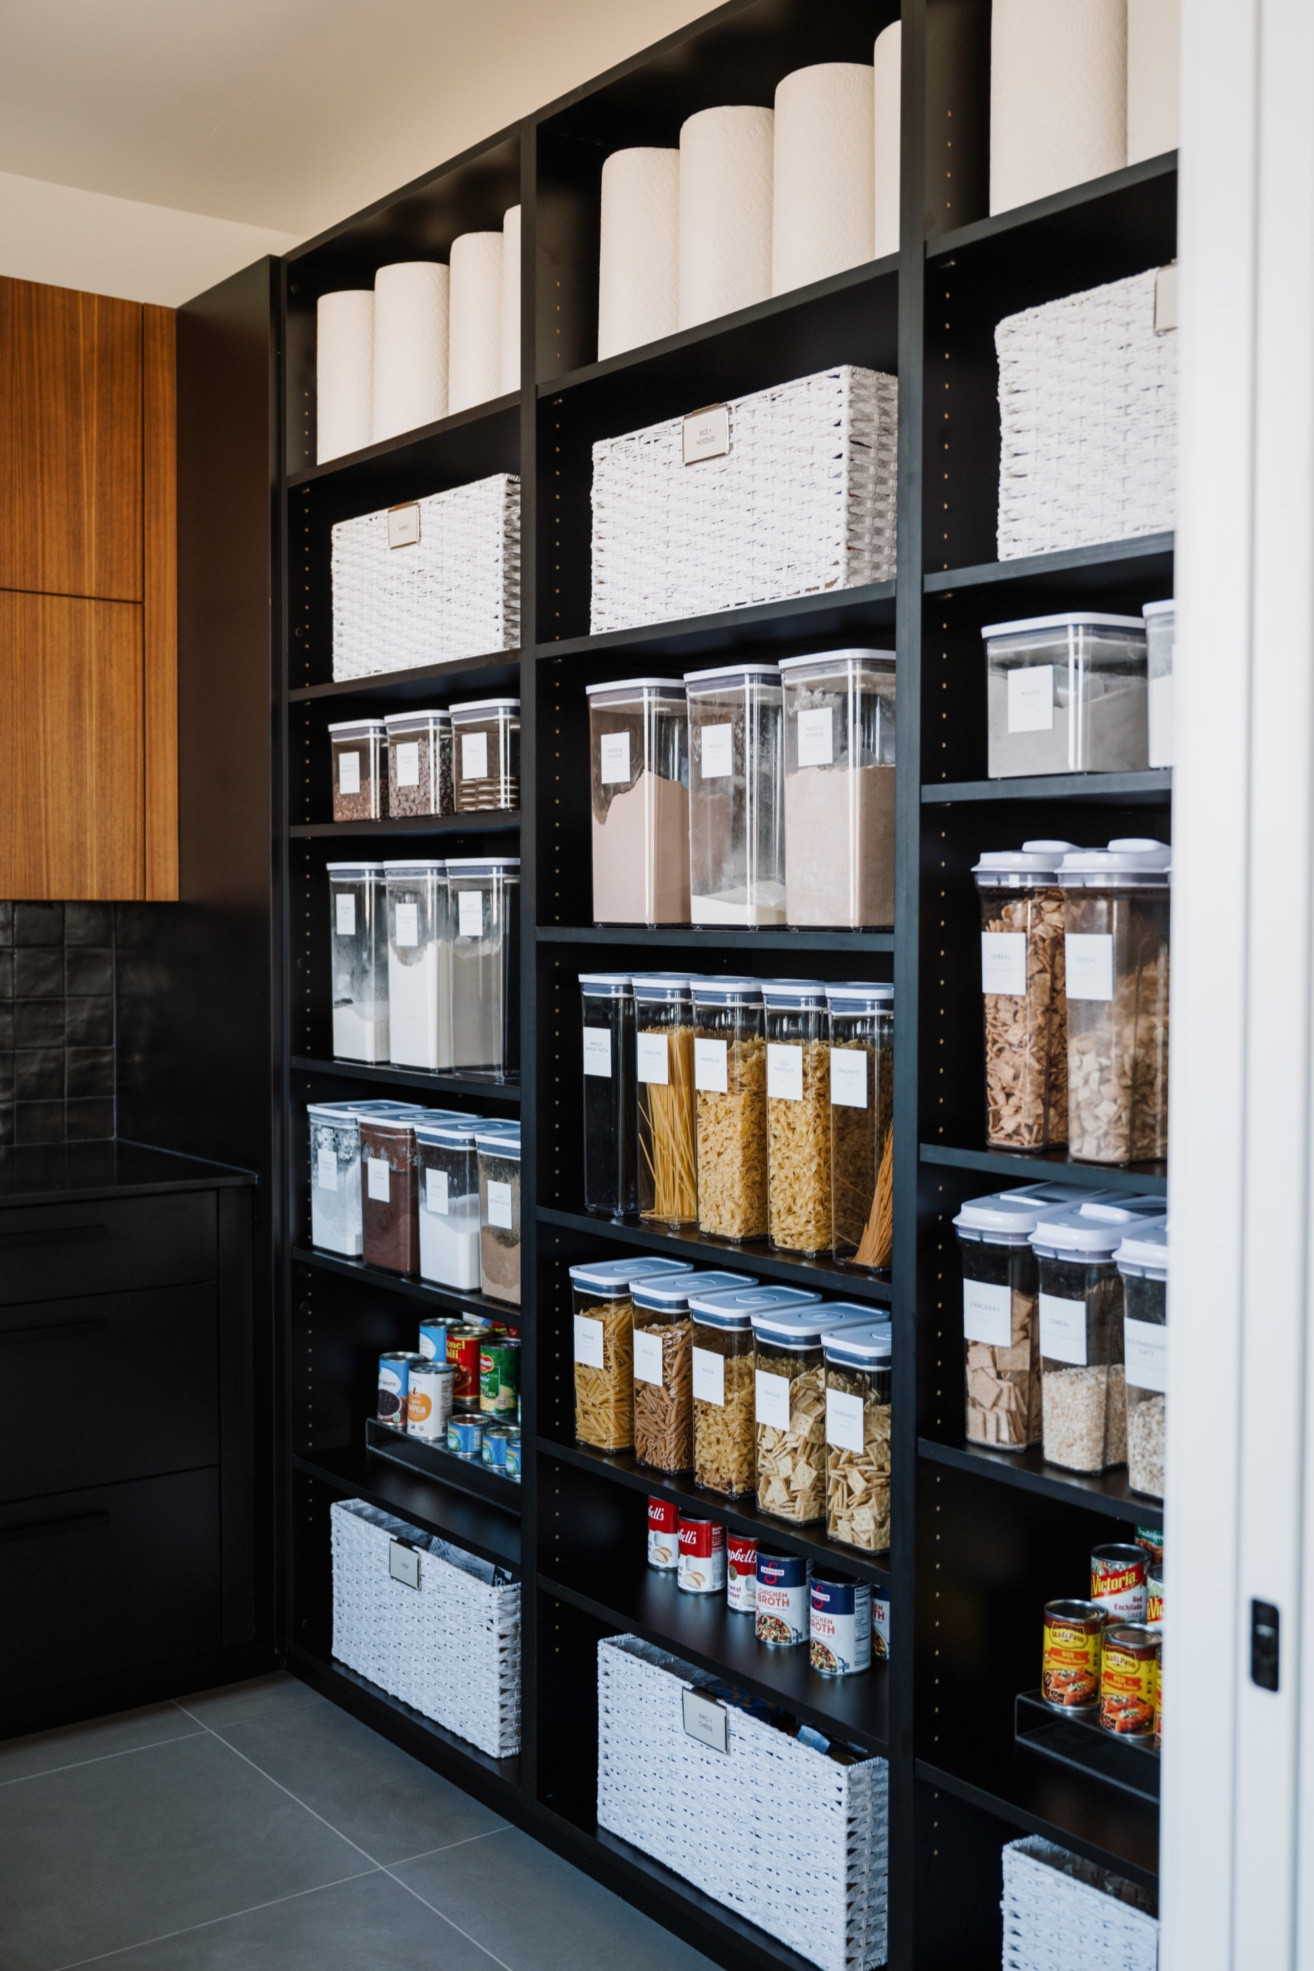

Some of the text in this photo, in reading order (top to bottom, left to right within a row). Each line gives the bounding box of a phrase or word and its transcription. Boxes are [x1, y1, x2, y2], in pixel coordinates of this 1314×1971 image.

[759, 1587, 788, 1598] CHICKEN
[758, 1594, 790, 1608] BROTH
[1114, 1603, 1142, 1611] Enchilada
